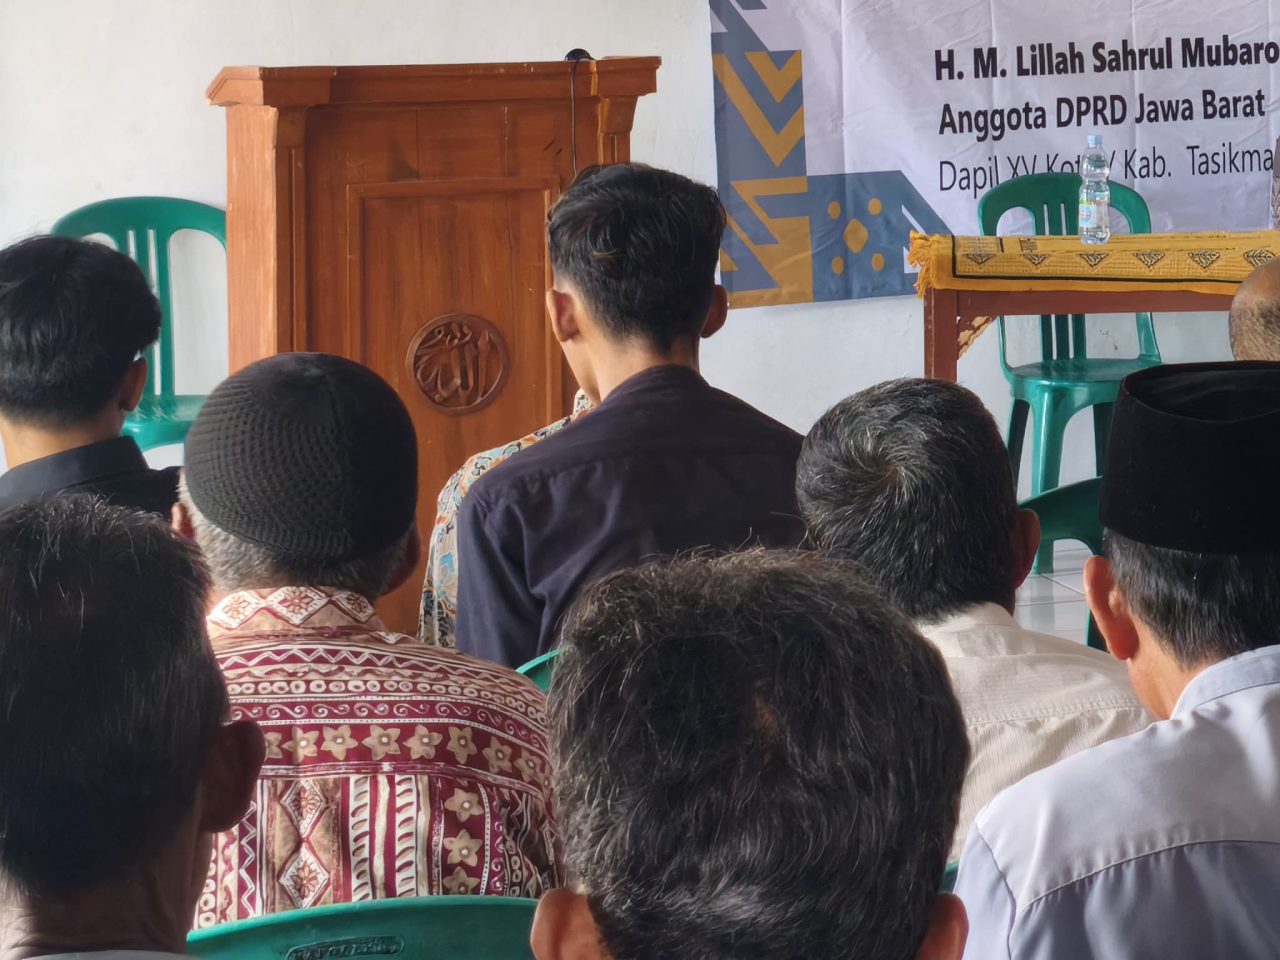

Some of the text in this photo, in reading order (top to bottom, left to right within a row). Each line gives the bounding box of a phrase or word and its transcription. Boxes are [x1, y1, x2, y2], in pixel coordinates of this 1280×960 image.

[935, 49, 965, 81] H.
[974, 46, 1007, 79] M.
[1016, 41, 1085, 77] Lillah
[1092, 36, 1173, 73] Sahrul
[938, 88, 1266, 143] Anggota DPRD Jawa Barat
[939, 155, 1000, 199] Dapil
[1046, 153, 1081, 173] Kot
[1124, 146, 1172, 180] Kab.
[1186, 141, 1274, 177] Tasikma
